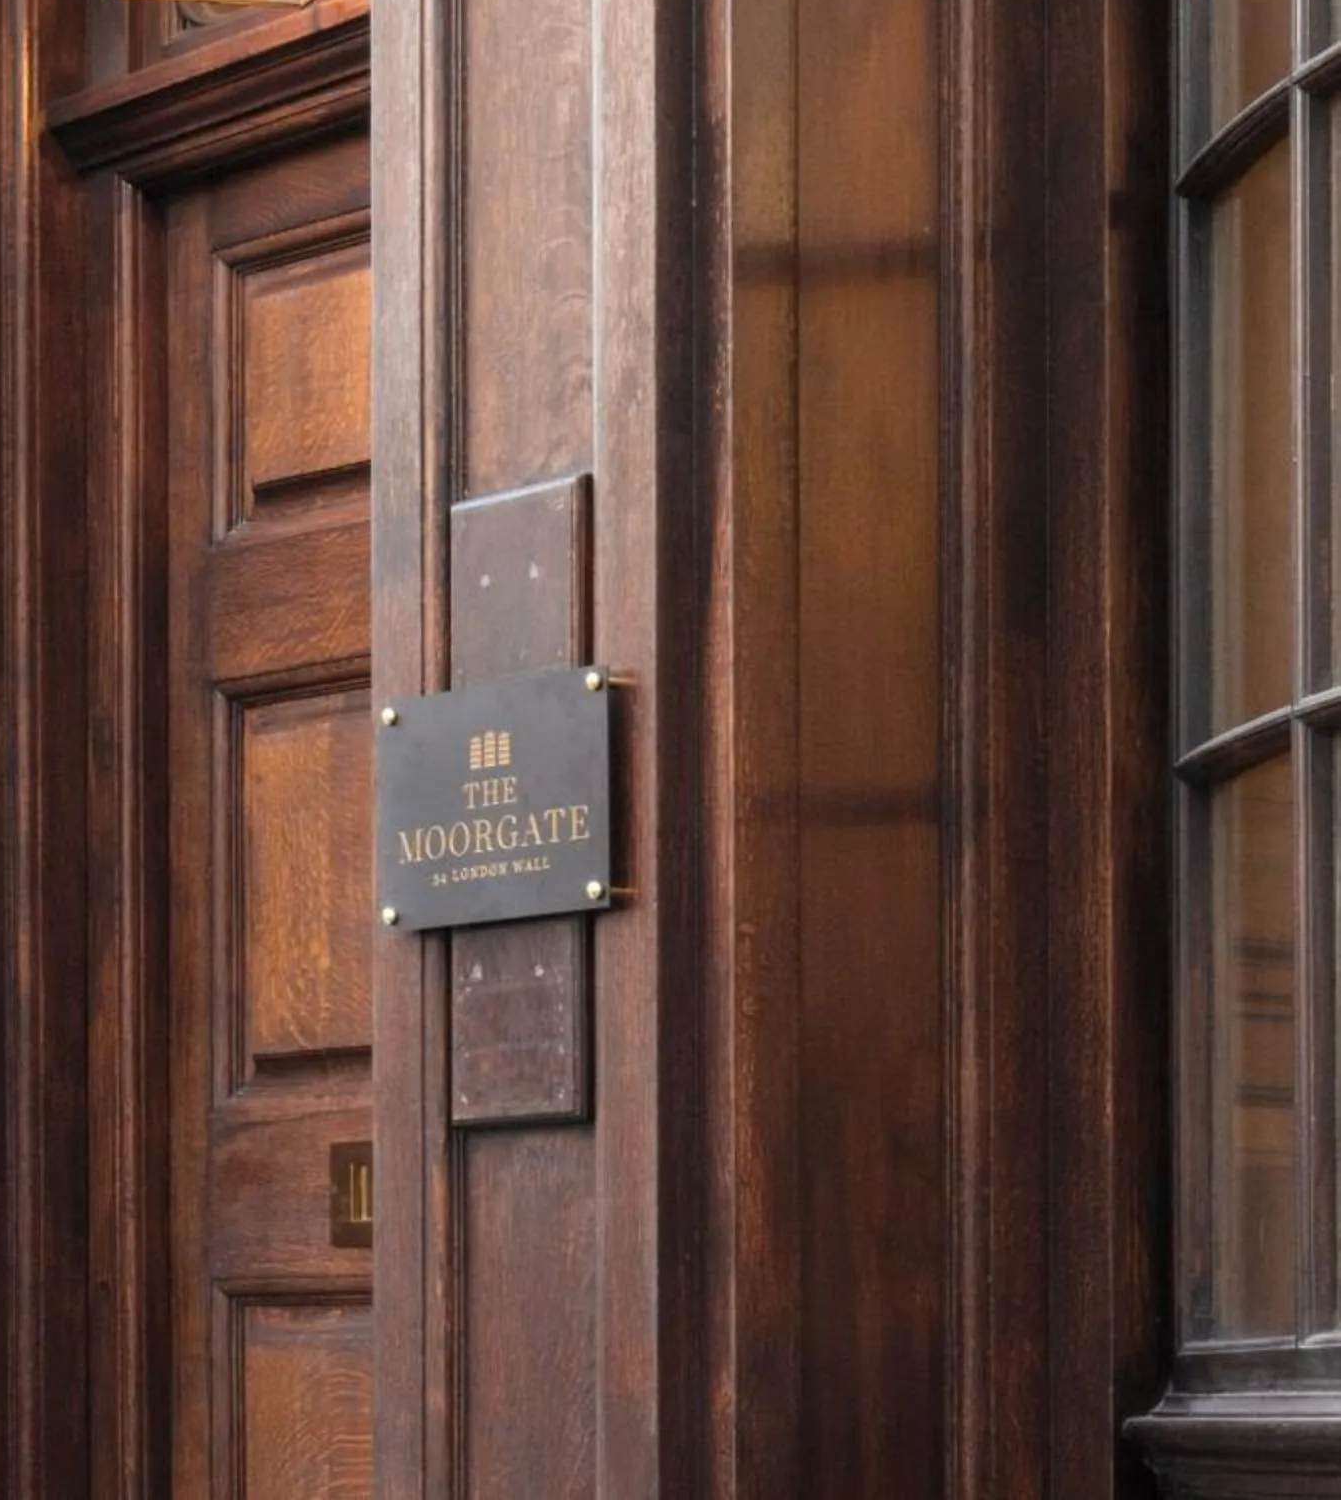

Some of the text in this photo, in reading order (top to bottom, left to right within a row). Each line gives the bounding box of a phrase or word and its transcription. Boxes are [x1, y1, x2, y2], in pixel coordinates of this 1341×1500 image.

[463, 776, 518, 809] THE
[397, 804, 590, 865] MOORGATE
[451, 861, 509, 881] LONDON
[512, 856, 551, 873] WALL
